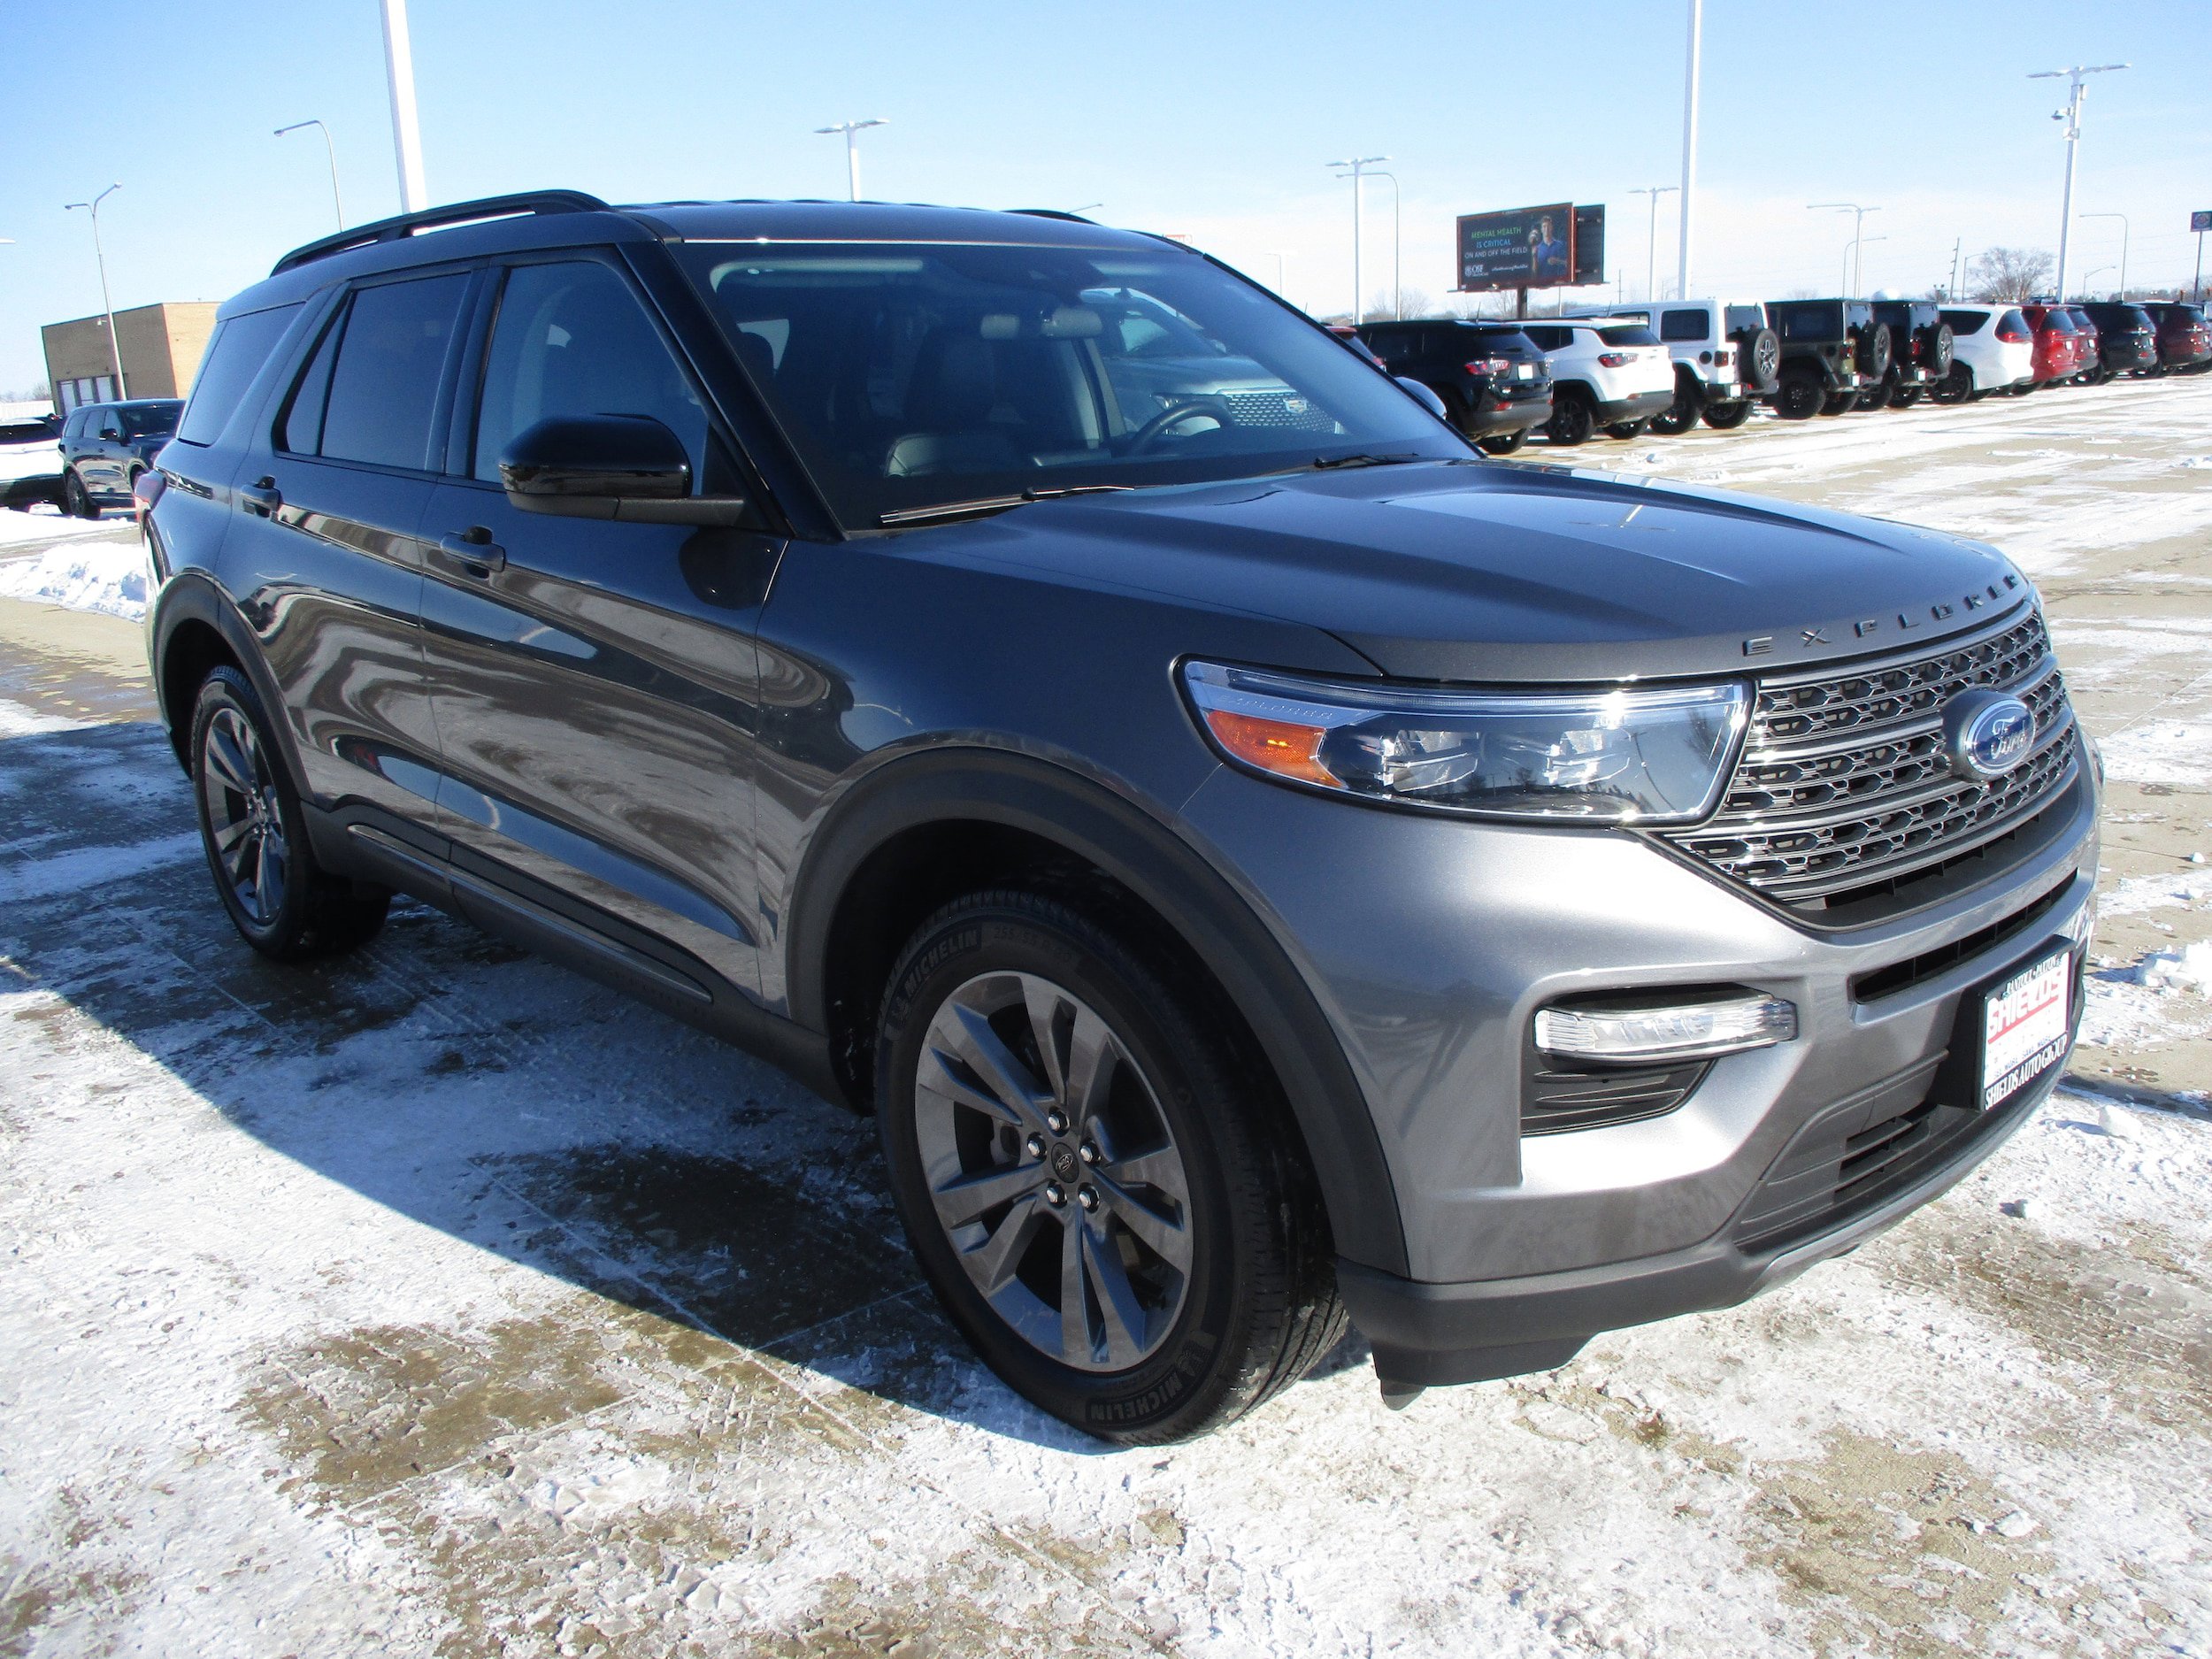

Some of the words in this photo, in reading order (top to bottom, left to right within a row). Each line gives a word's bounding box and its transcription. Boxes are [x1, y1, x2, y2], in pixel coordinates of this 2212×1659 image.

[1471, 230, 1495, 239] MENTAL
[1497, 227, 1522, 235] HEALTH
[1483, 239, 1511, 248] CRITICAL
[1742, 573, 2019, 657] EXPLORER
[1989, 715, 2029, 761] Ford
[904, 928, 980, 998] MICHELIN
[1987, 971, 2062, 1037] SHIELDS
[1985, 1069, 2019, 1111] SHIELDS
[2018, 1054, 2041, 1087] AUTO
[2041, 1033, 2068, 1069] GROUP
[1089, 1371, 1184, 1421] MICHELIN
